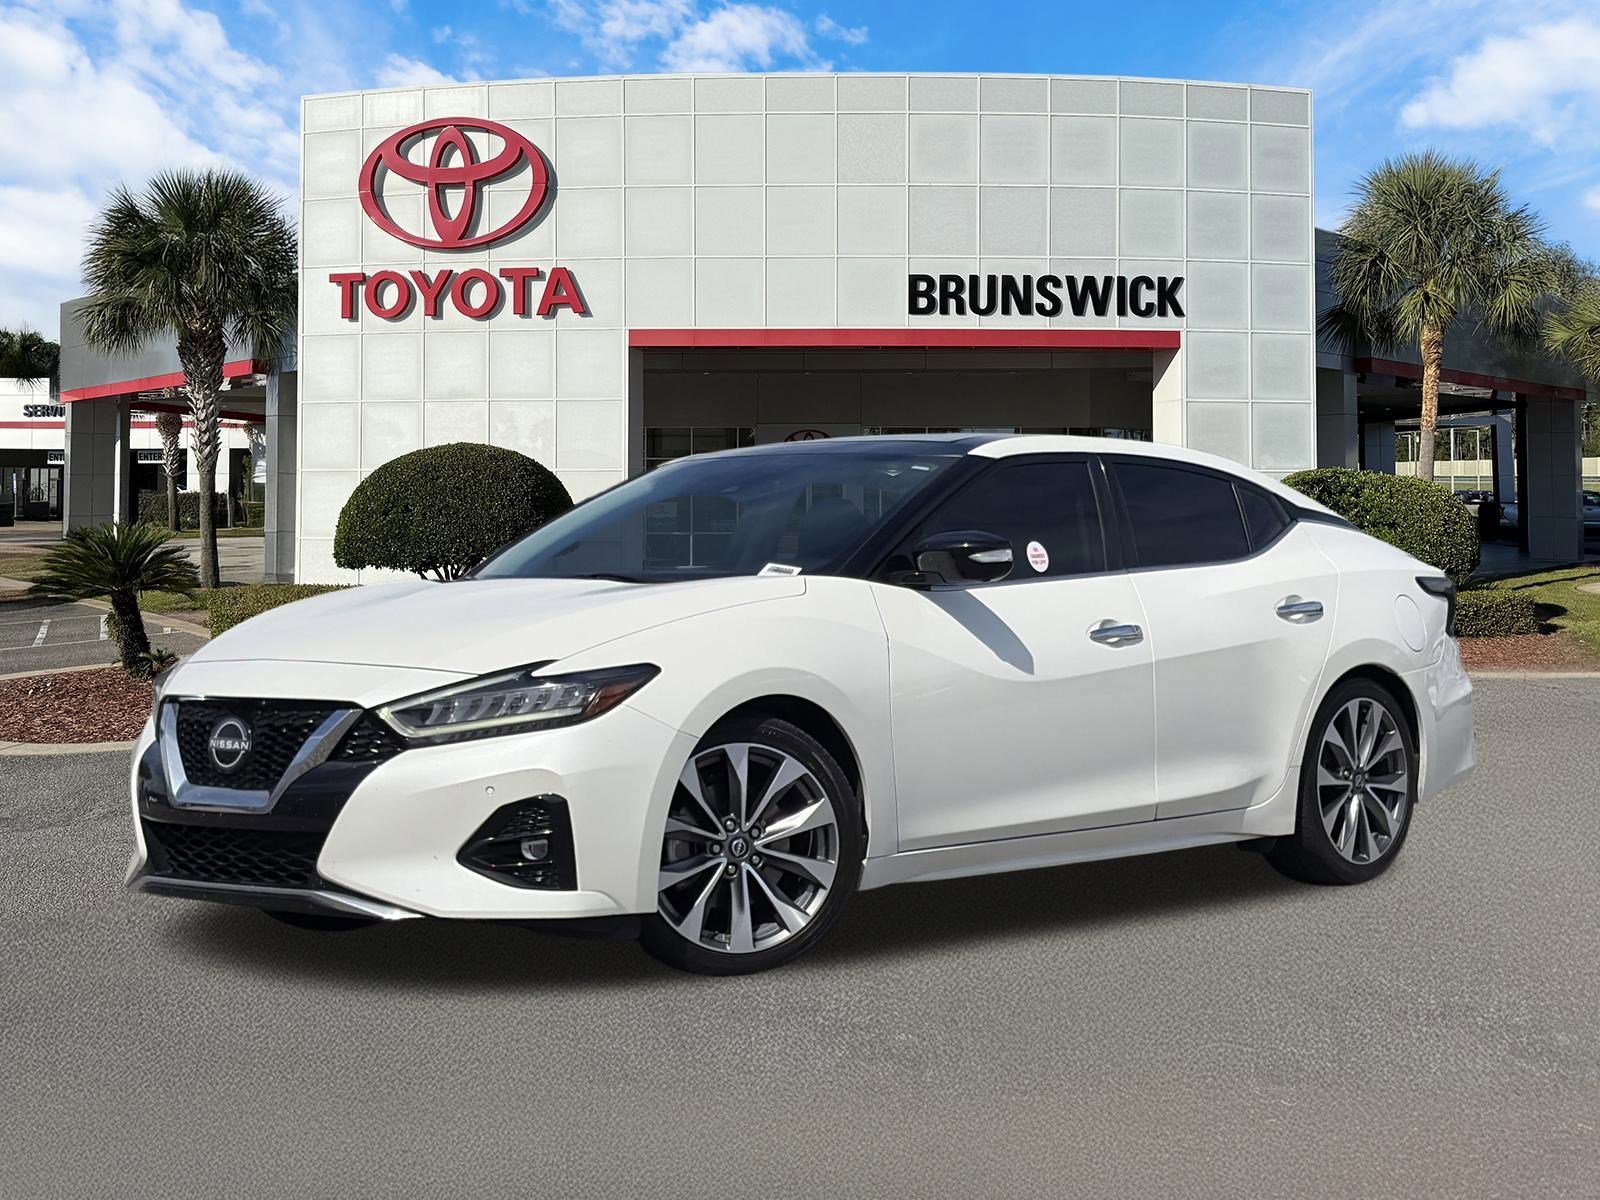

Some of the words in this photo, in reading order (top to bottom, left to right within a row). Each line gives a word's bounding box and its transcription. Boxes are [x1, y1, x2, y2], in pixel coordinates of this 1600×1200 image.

[329, 267, 587, 319] TOYOTA
[908, 274, 1186, 317] BRUNSWICK
[23, 404, 65, 417] SERVI
[48, 453, 65, 461] ENT
[210, 739, 249, 750] NISSAN
